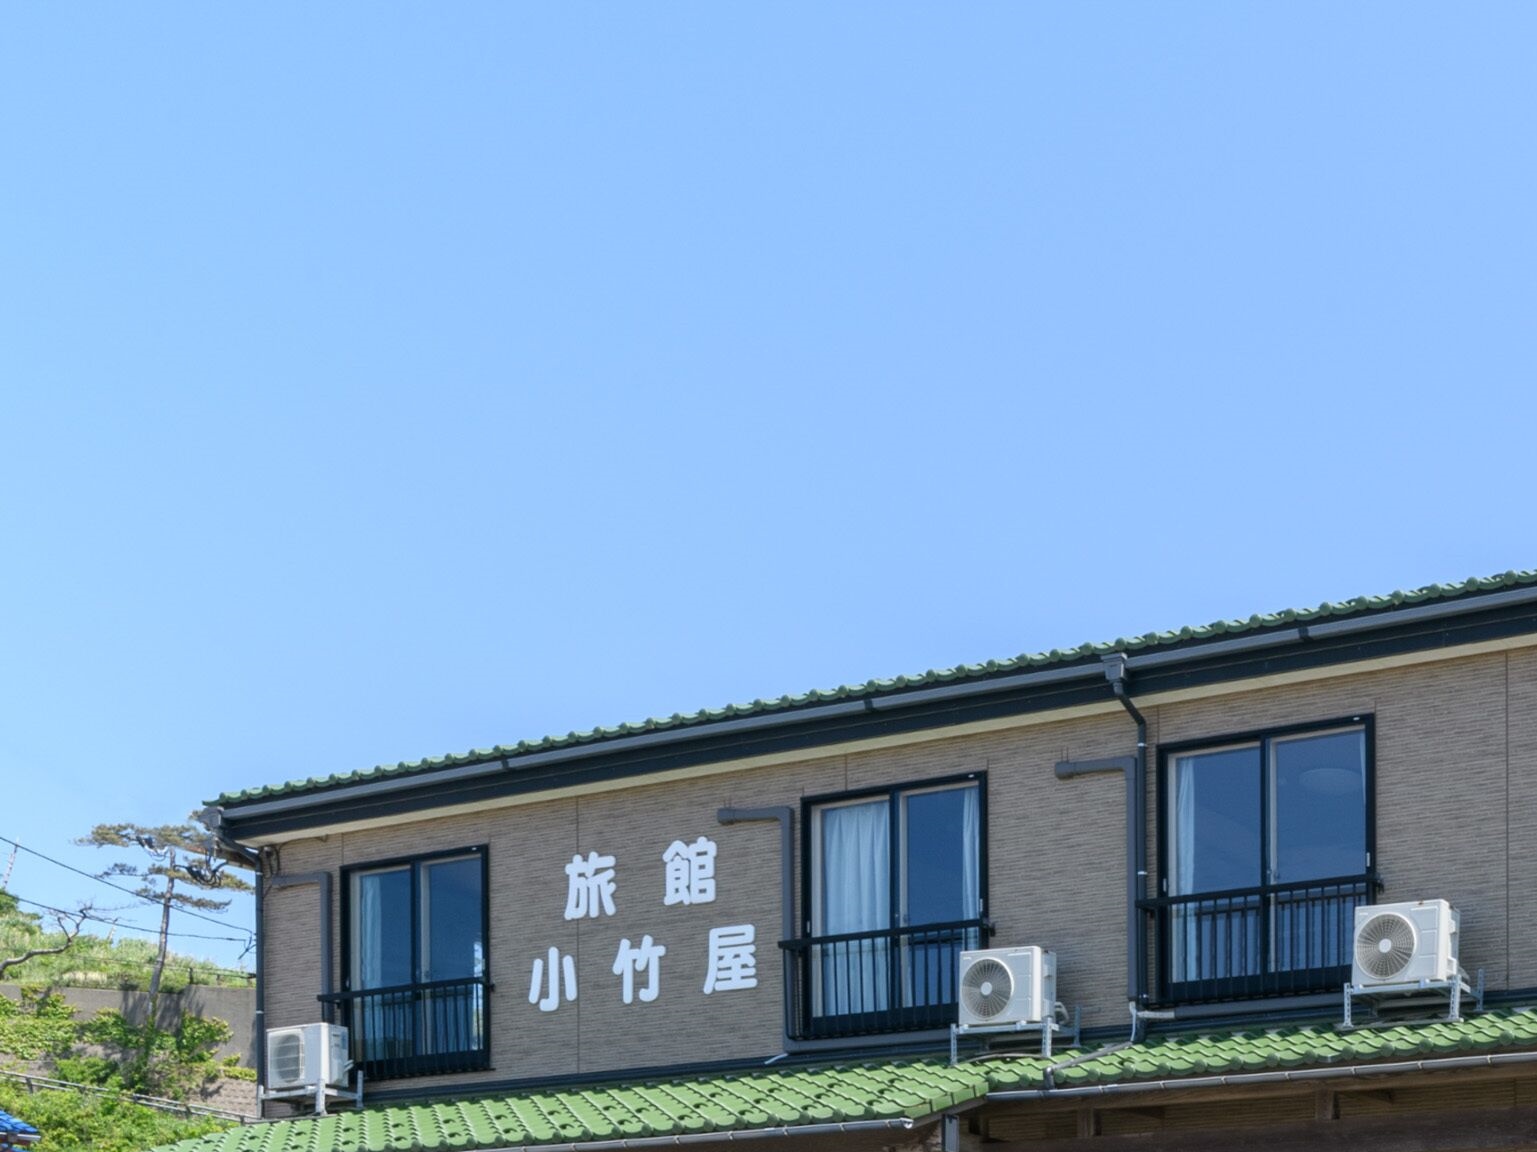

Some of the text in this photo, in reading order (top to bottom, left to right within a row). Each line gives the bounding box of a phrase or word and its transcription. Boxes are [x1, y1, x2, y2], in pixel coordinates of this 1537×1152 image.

[564, 836, 717, 920] 旅館
[528, 924, 758, 1012] 小竹屋
